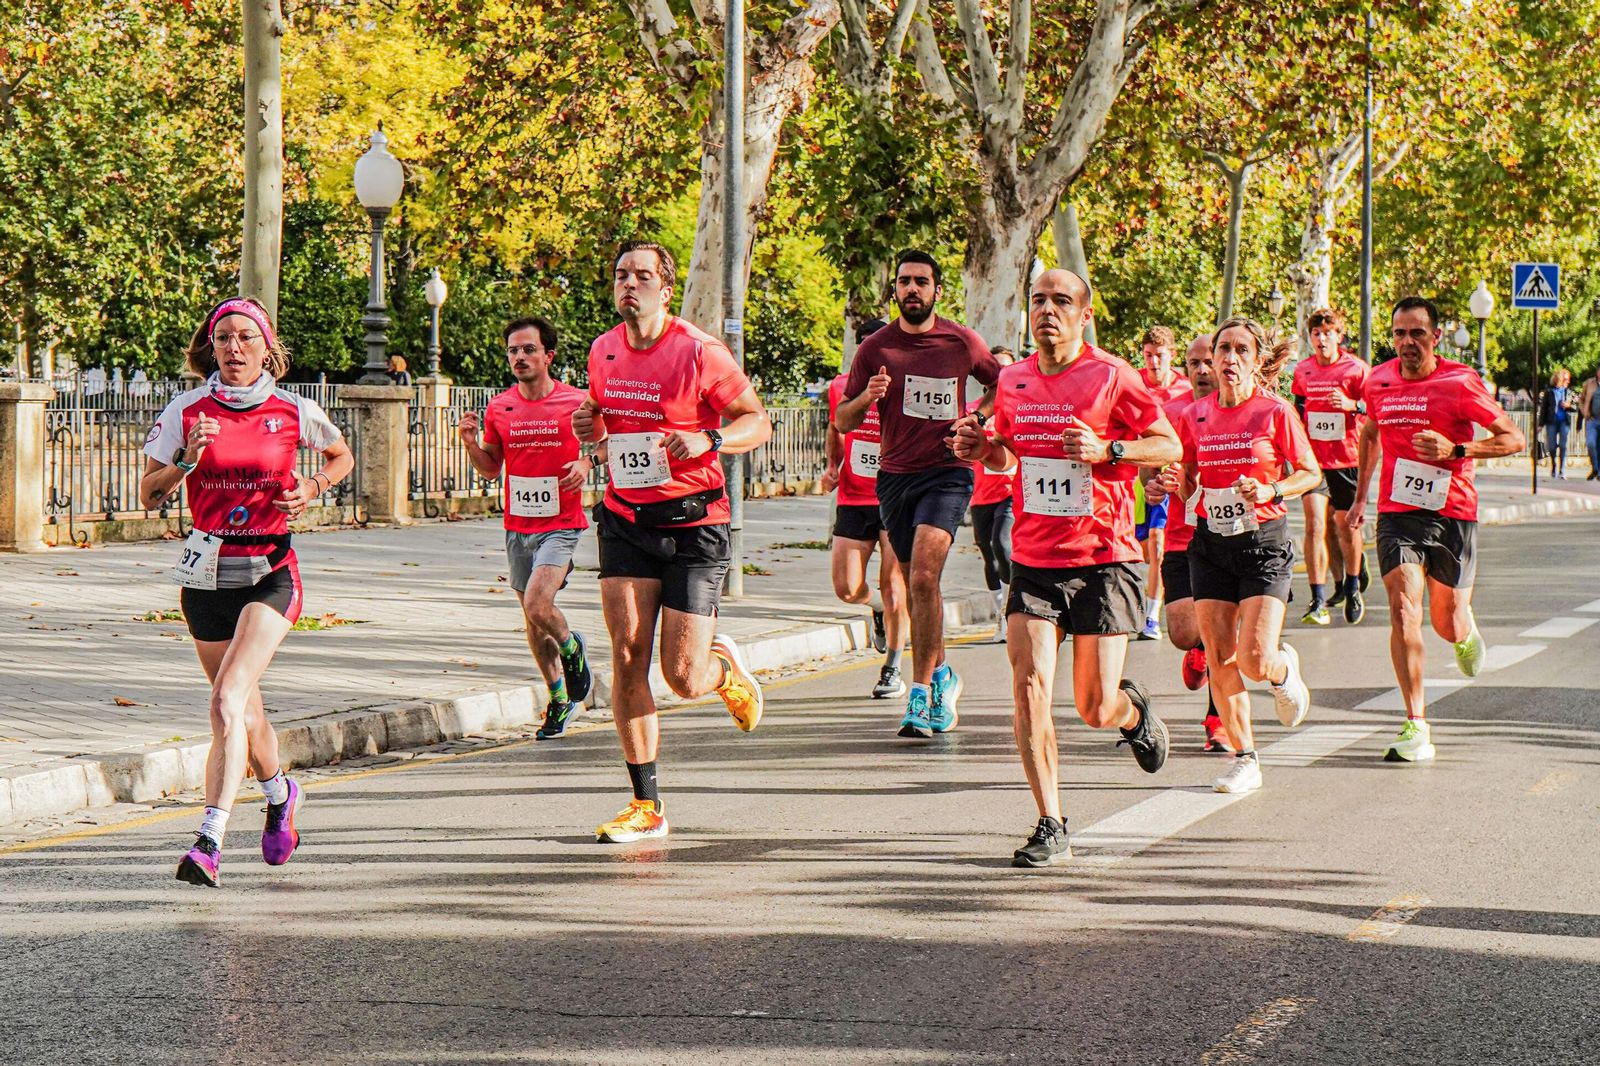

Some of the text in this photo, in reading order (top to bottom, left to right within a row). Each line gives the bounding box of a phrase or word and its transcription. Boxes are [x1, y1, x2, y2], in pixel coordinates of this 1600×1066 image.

[606, 377, 661, 391] kilómetros de
[604, 388, 660, 402] humanidad
[913, 391, 951, 405] 1150
[1016, 403, 1074, 411] kilómetros de
[1381, 403, 1427, 412] humanidad
[602, 407, 664, 420] #CarreraCruzRoja
[1015, 414, 1073, 424] humanidad
[510, 427, 559, 436] humanidad
[1316, 422, 1335, 430] 491
[1199, 432, 1239, 441] kilómetros
[1199, 441, 1253, 452] humanidad
[619, 452, 651, 468] 133
[1036, 478, 1071, 495] 111
[1405, 475, 1434, 493] 791
[516, 491, 551, 502] 1410
[1208, 502, 1245, 519] 1283
